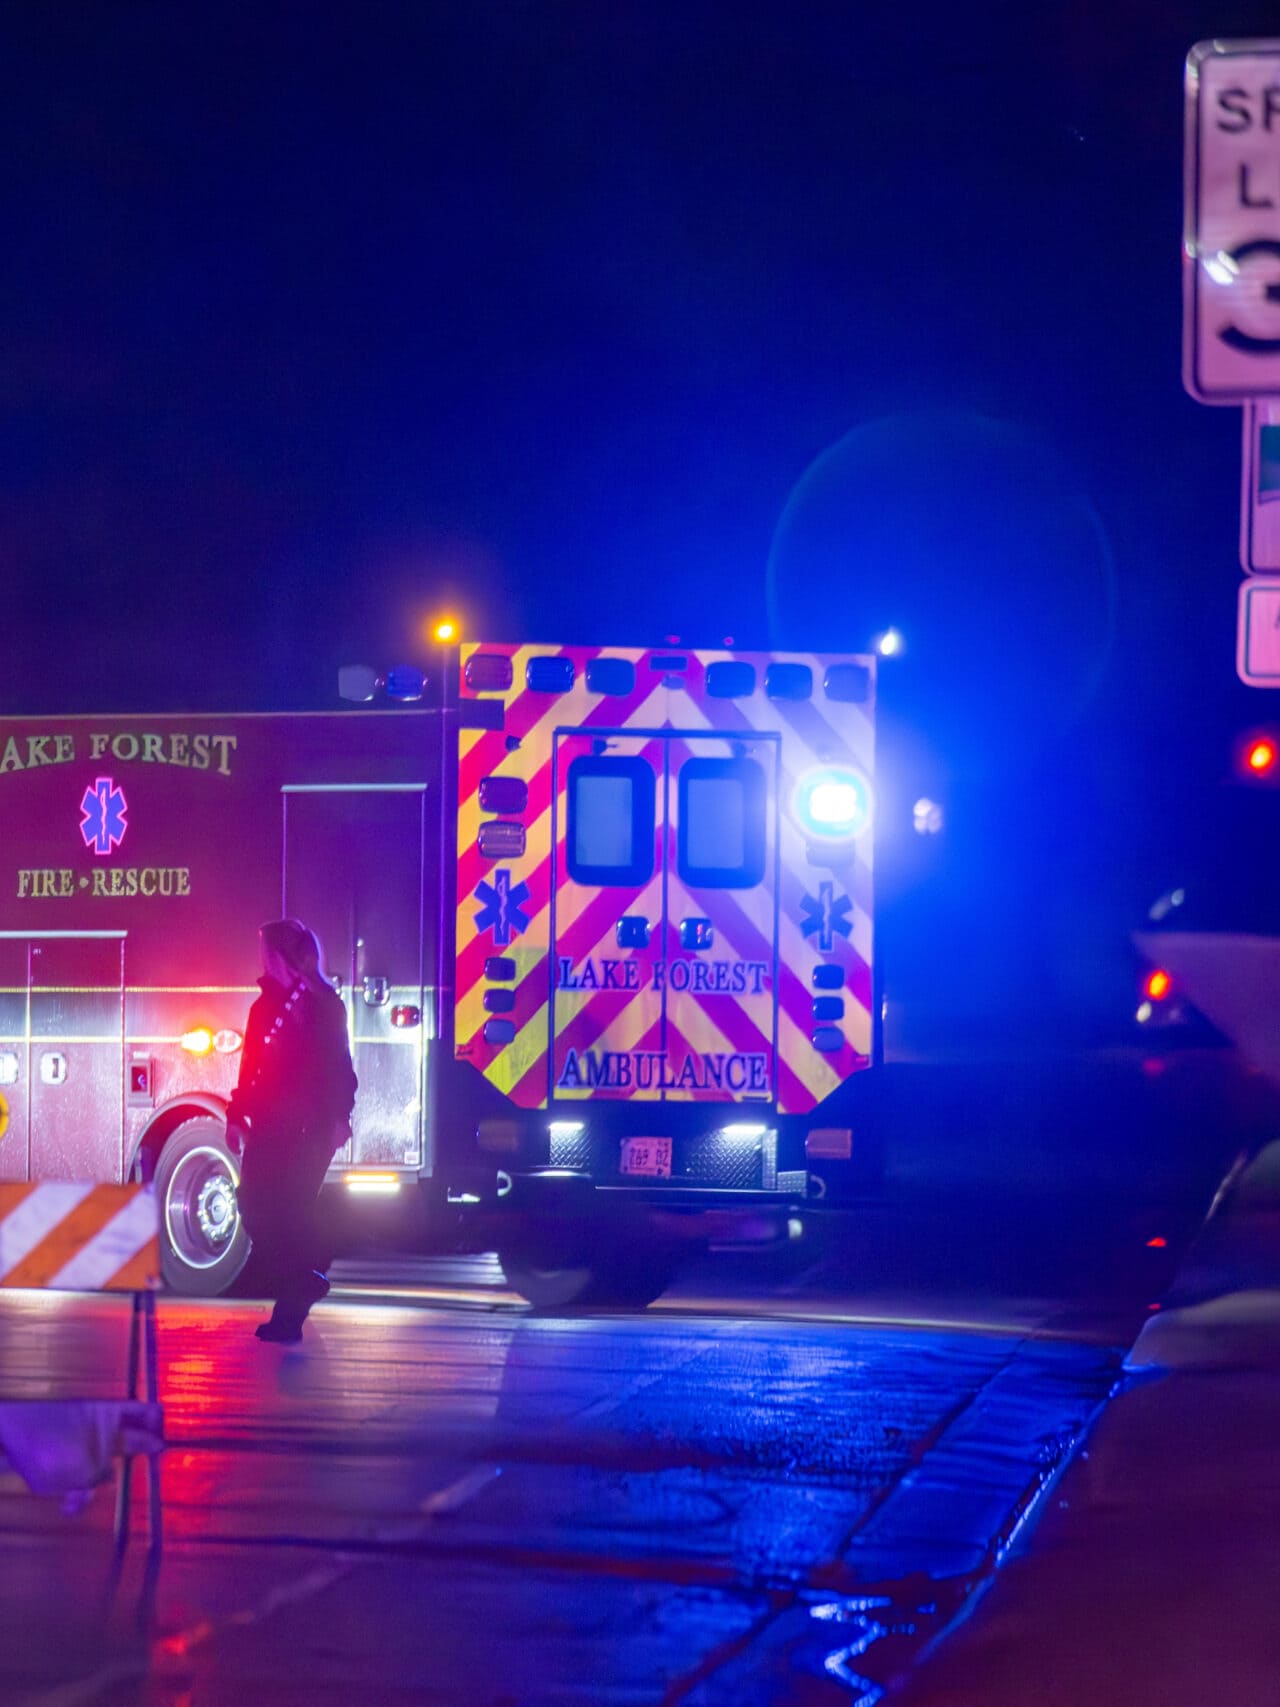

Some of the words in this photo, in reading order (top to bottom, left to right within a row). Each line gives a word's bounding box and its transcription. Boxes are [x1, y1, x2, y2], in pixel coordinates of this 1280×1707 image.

[89, 733, 237, 776] FOREST
[558, 957, 640, 991] LAKE
[651, 959, 769, 995] FOREST
[558, 1049, 769, 1092] AMBULANCE
